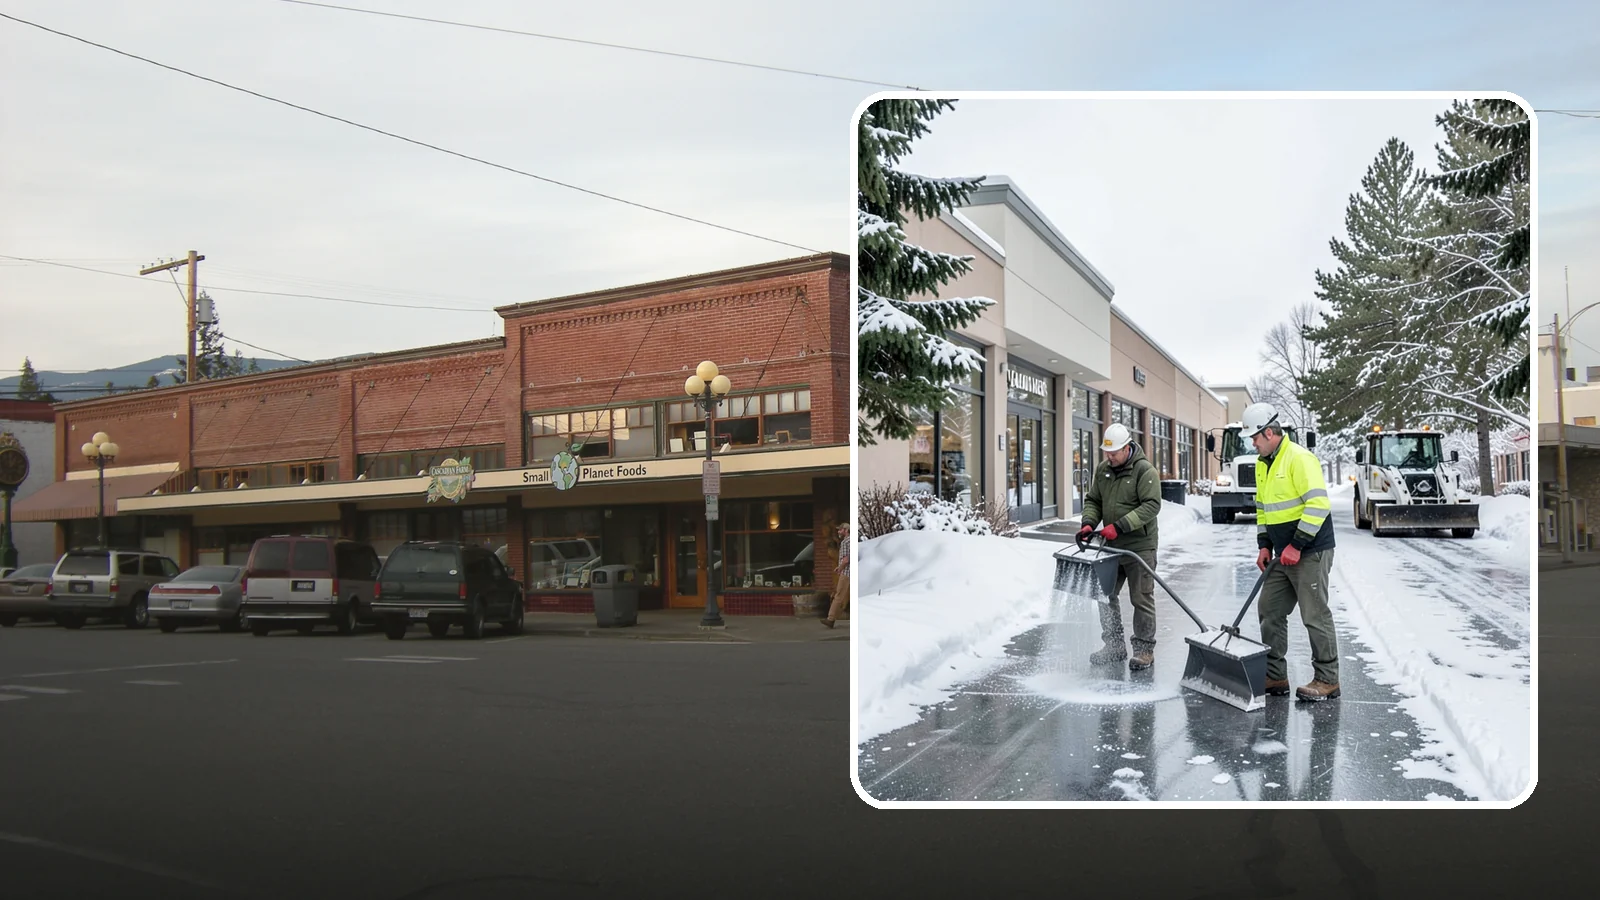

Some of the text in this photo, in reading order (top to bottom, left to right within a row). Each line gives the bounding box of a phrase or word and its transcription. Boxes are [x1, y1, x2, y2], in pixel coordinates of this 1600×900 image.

[523, 464, 647, 483] Small Planet Foods
